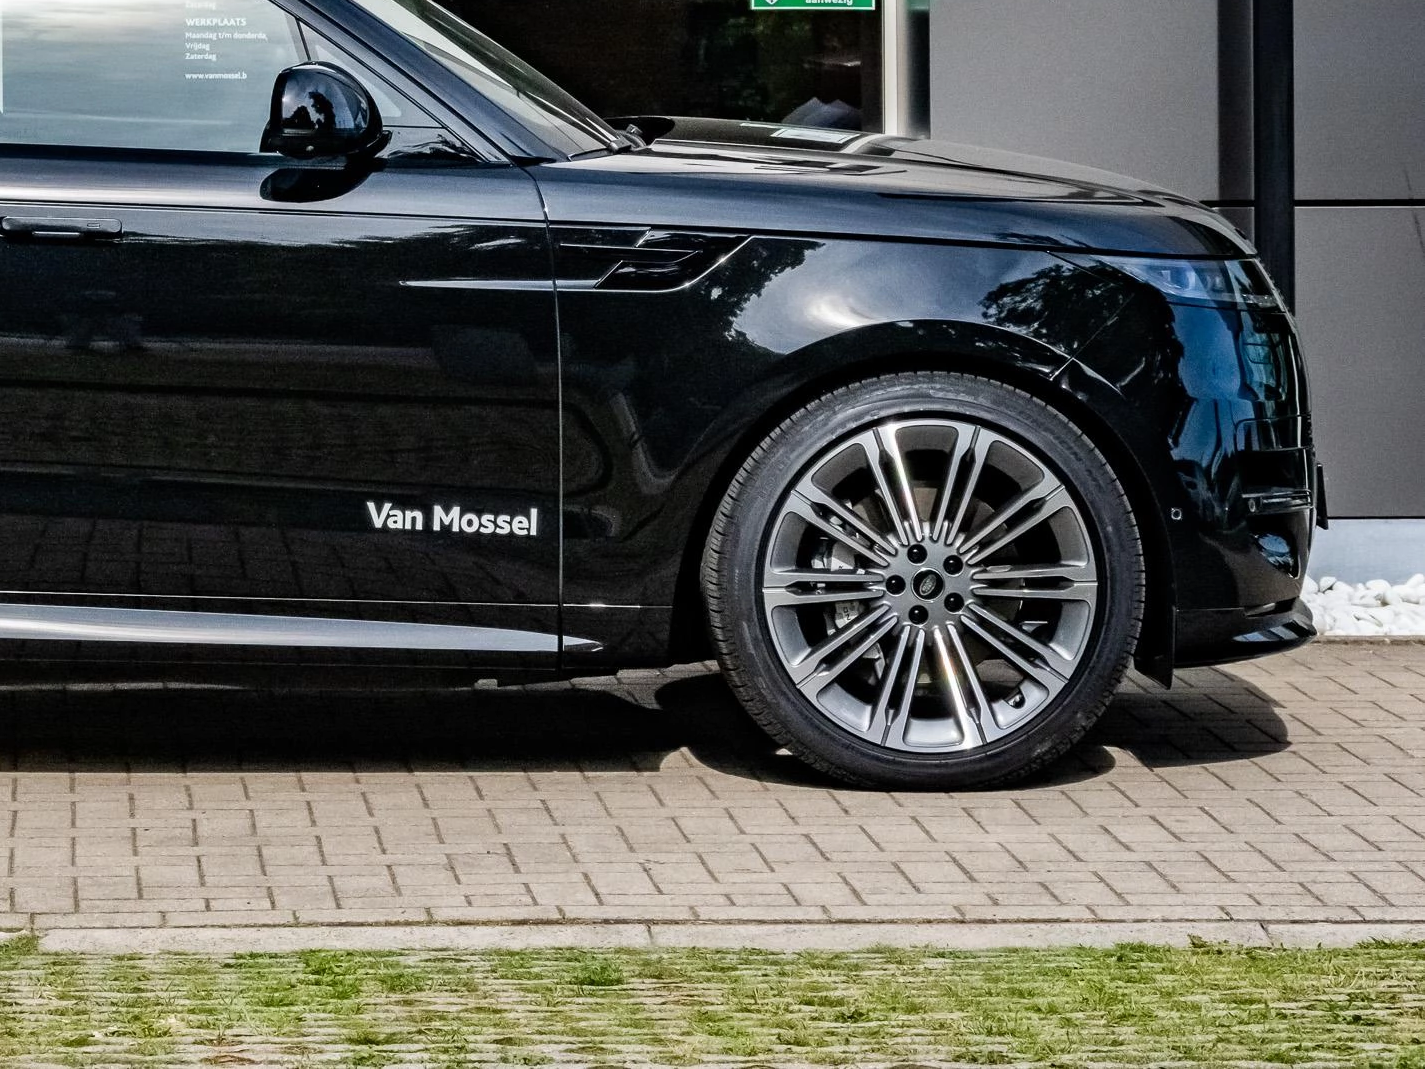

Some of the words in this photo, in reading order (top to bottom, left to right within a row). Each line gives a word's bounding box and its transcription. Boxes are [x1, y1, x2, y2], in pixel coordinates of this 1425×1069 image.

[185, 17, 248, 27] WERKPLAATS
[185, 32, 217, 40] Maandag
[233, 32, 268, 41] donderda
[185, 43, 210, 51] Vrijdag
[185, 53, 217, 61] Zaterdag
[366, 500, 423, 531] Van
[433, 504, 538, 536] Mossel
